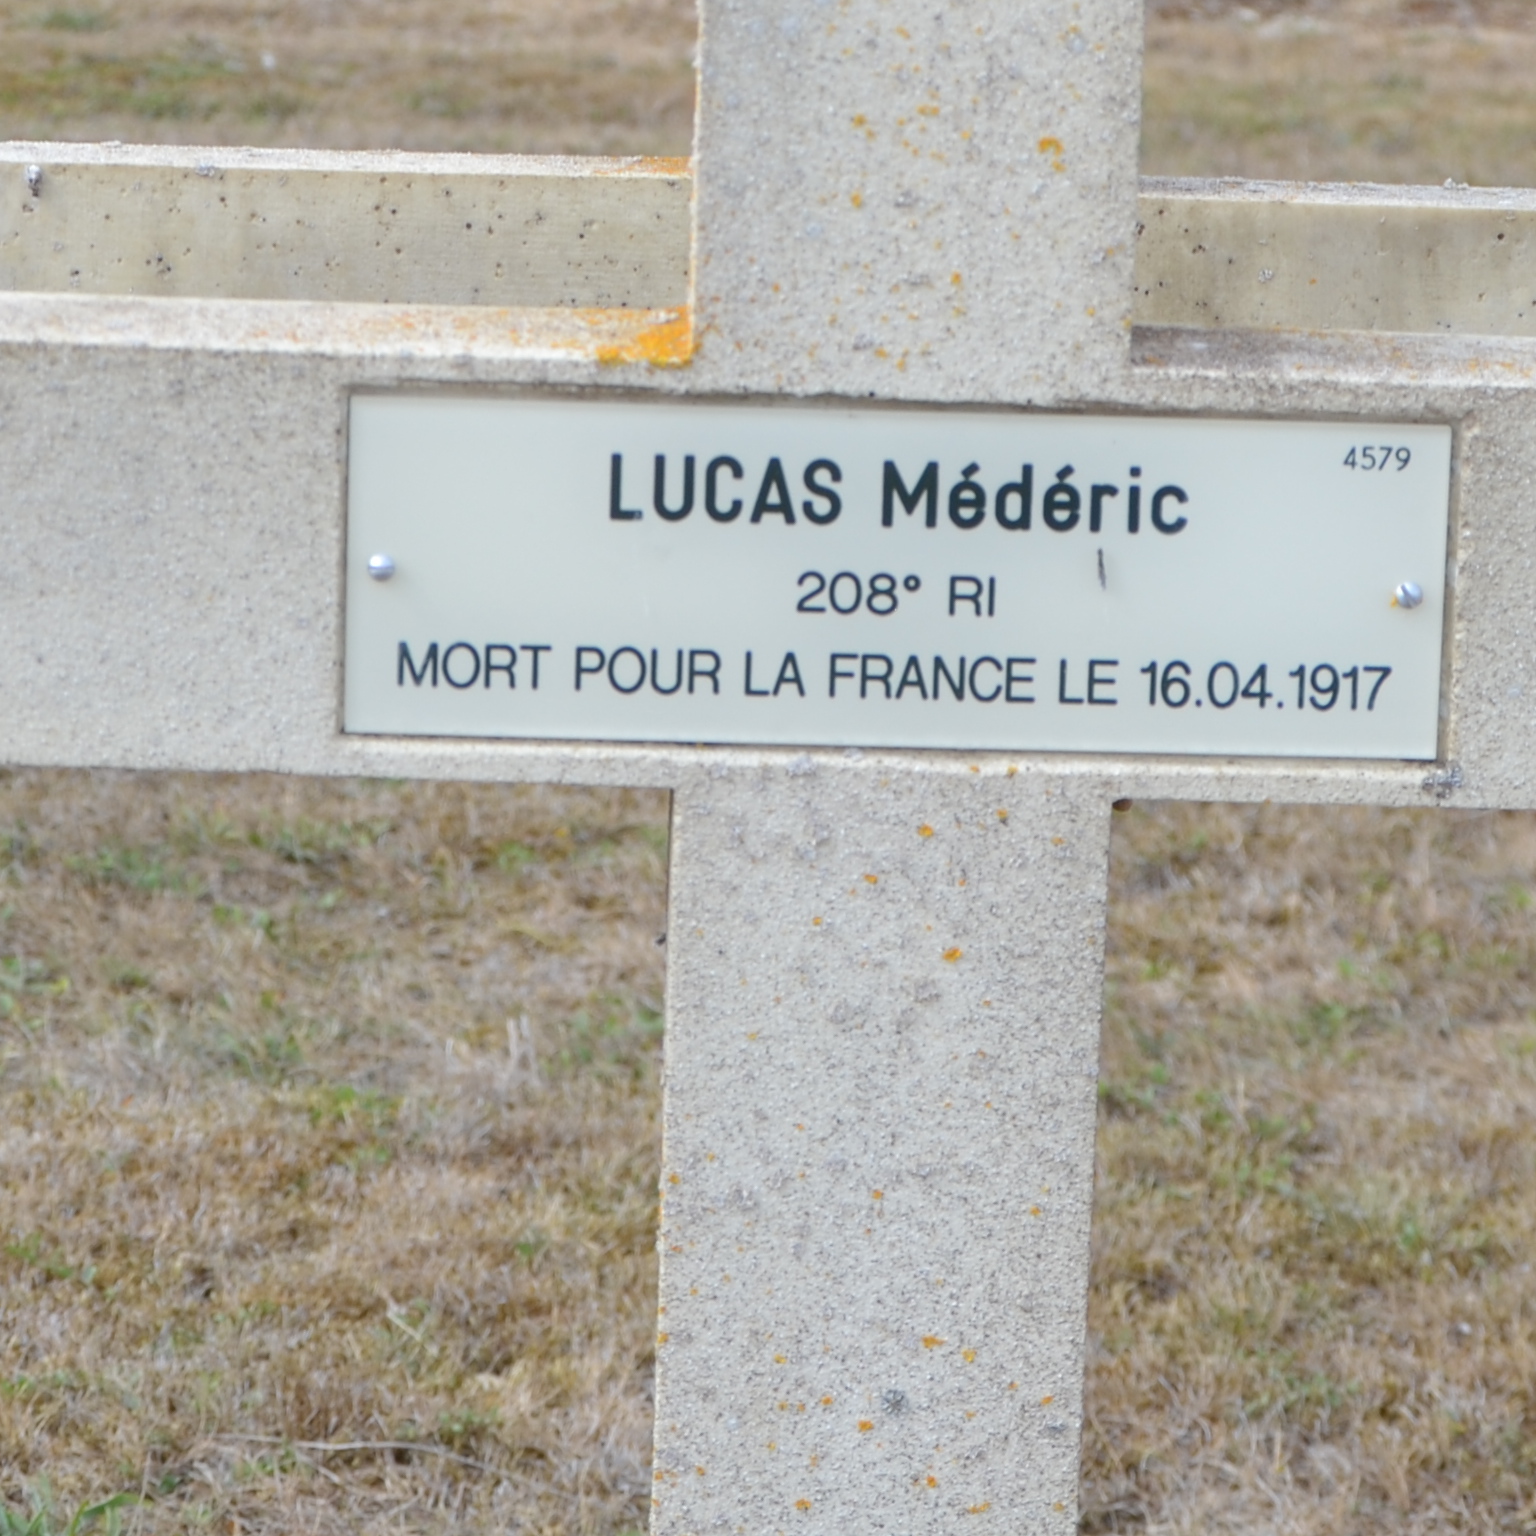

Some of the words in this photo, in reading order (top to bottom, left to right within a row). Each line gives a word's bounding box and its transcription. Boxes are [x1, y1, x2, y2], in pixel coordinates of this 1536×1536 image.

[1343, 446, 1411, 471] 4579
[609, 453, 843, 526] LUCAS
[881, 460, 1188, 535] Médéric
[796, 570, 921, 616] 208°
[948, 575, 996, 617] RI
[397, 642, 552, 690] MORT
[574, 646, 722, 696] POUR
[744, 651, 805, 697] LA
[828, 652, 1037, 704] FRANCE
[1058, 658, 1119, 706] LE
[1140, 660, 1392, 712] 16.04.1917
